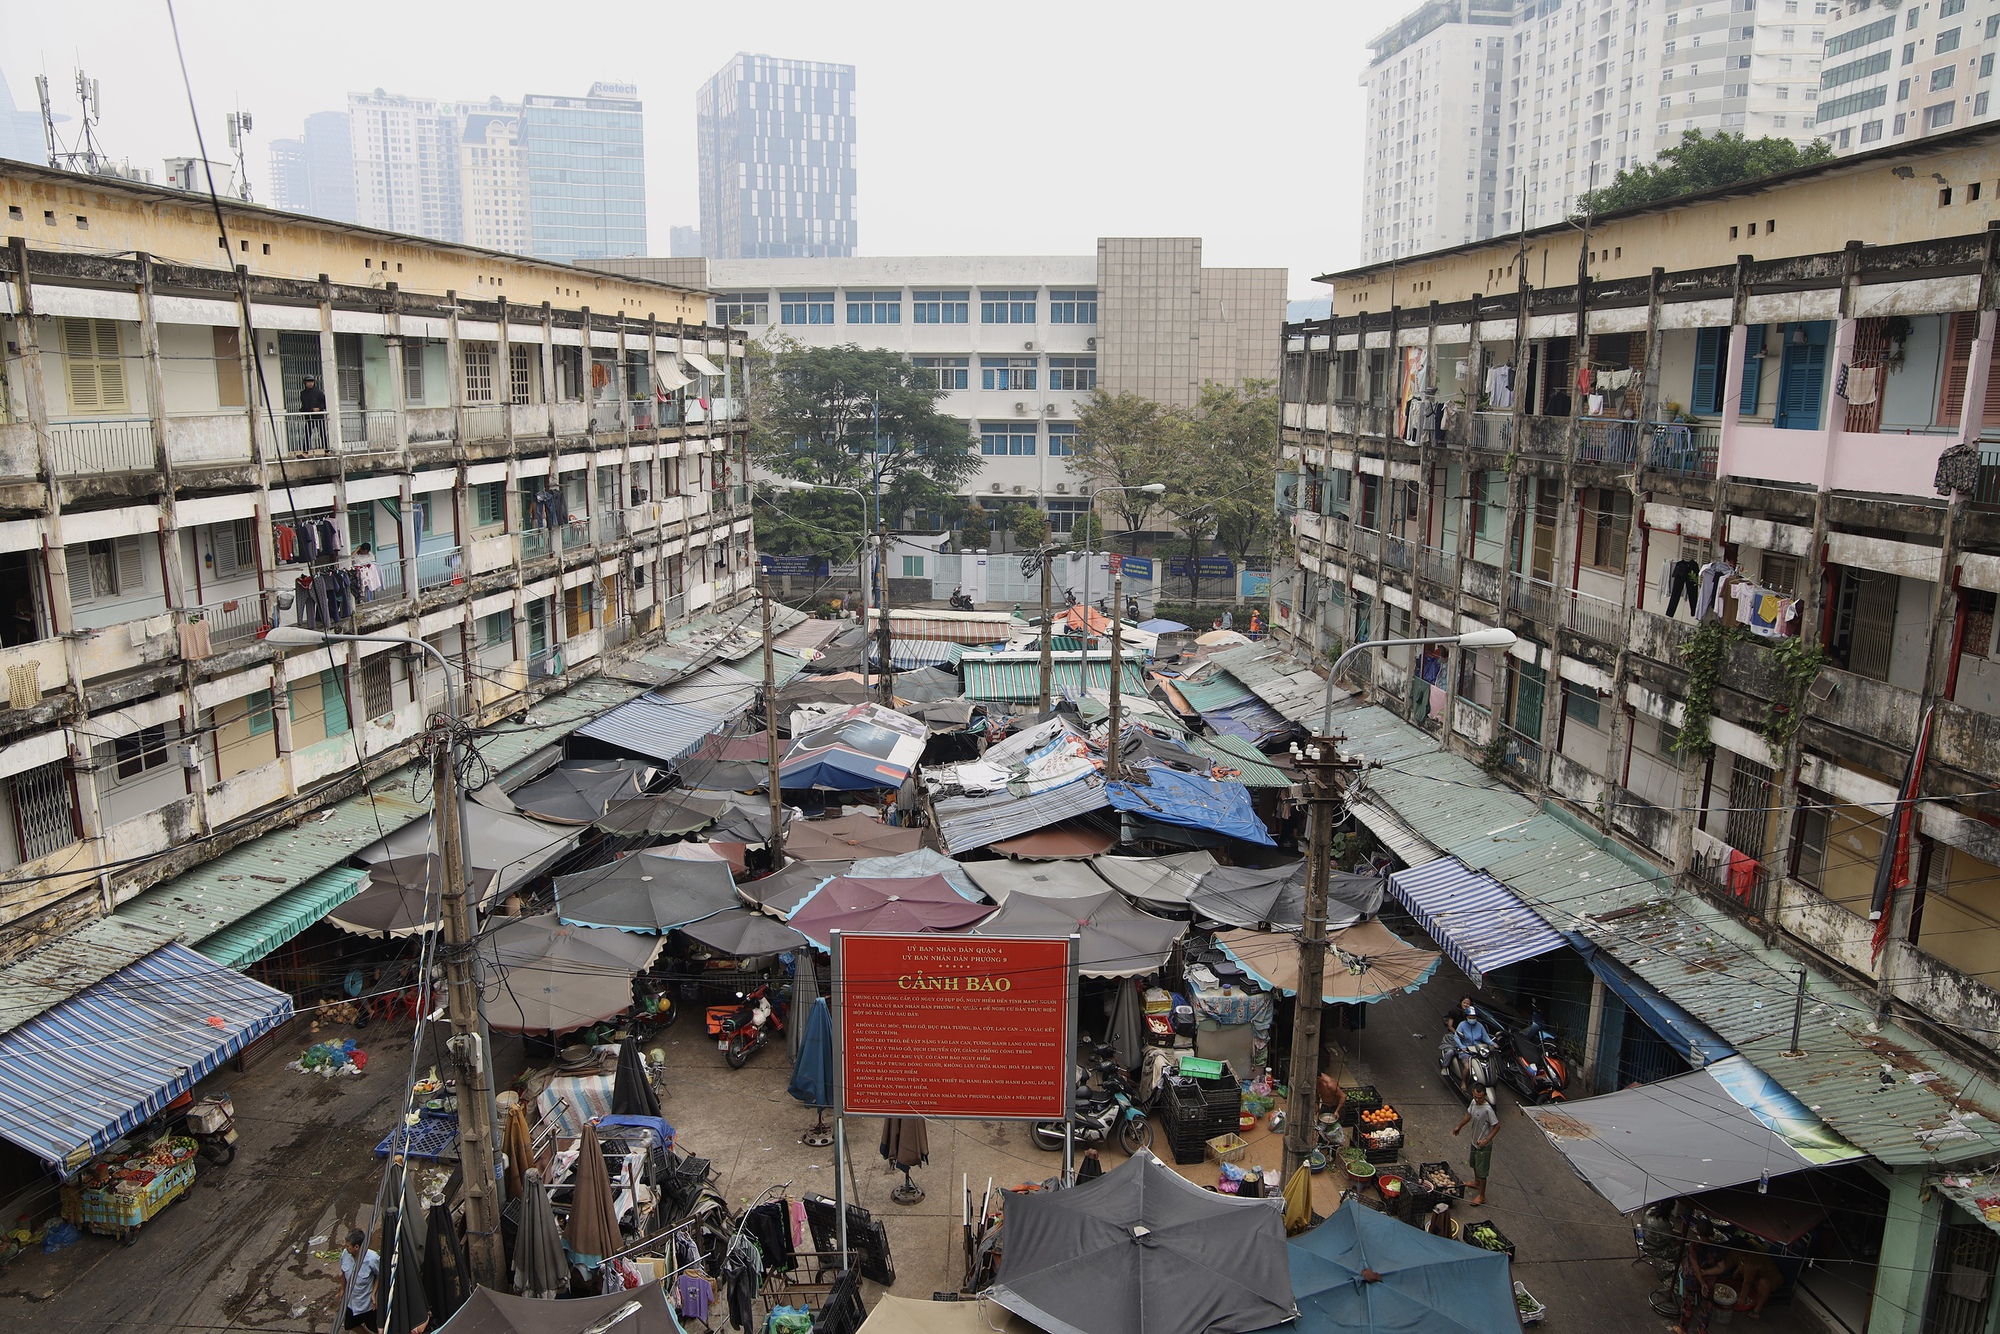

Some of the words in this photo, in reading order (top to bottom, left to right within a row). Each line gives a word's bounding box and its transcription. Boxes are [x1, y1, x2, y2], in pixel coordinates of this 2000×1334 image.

[594, 81, 637, 94] Reetech
[936, 944, 956, 952] NHÂN
[975, 945, 996, 954] QUẬN
[898, 969, 959, 990] CẢNH
[965, 972, 1010, 991] BÁO
